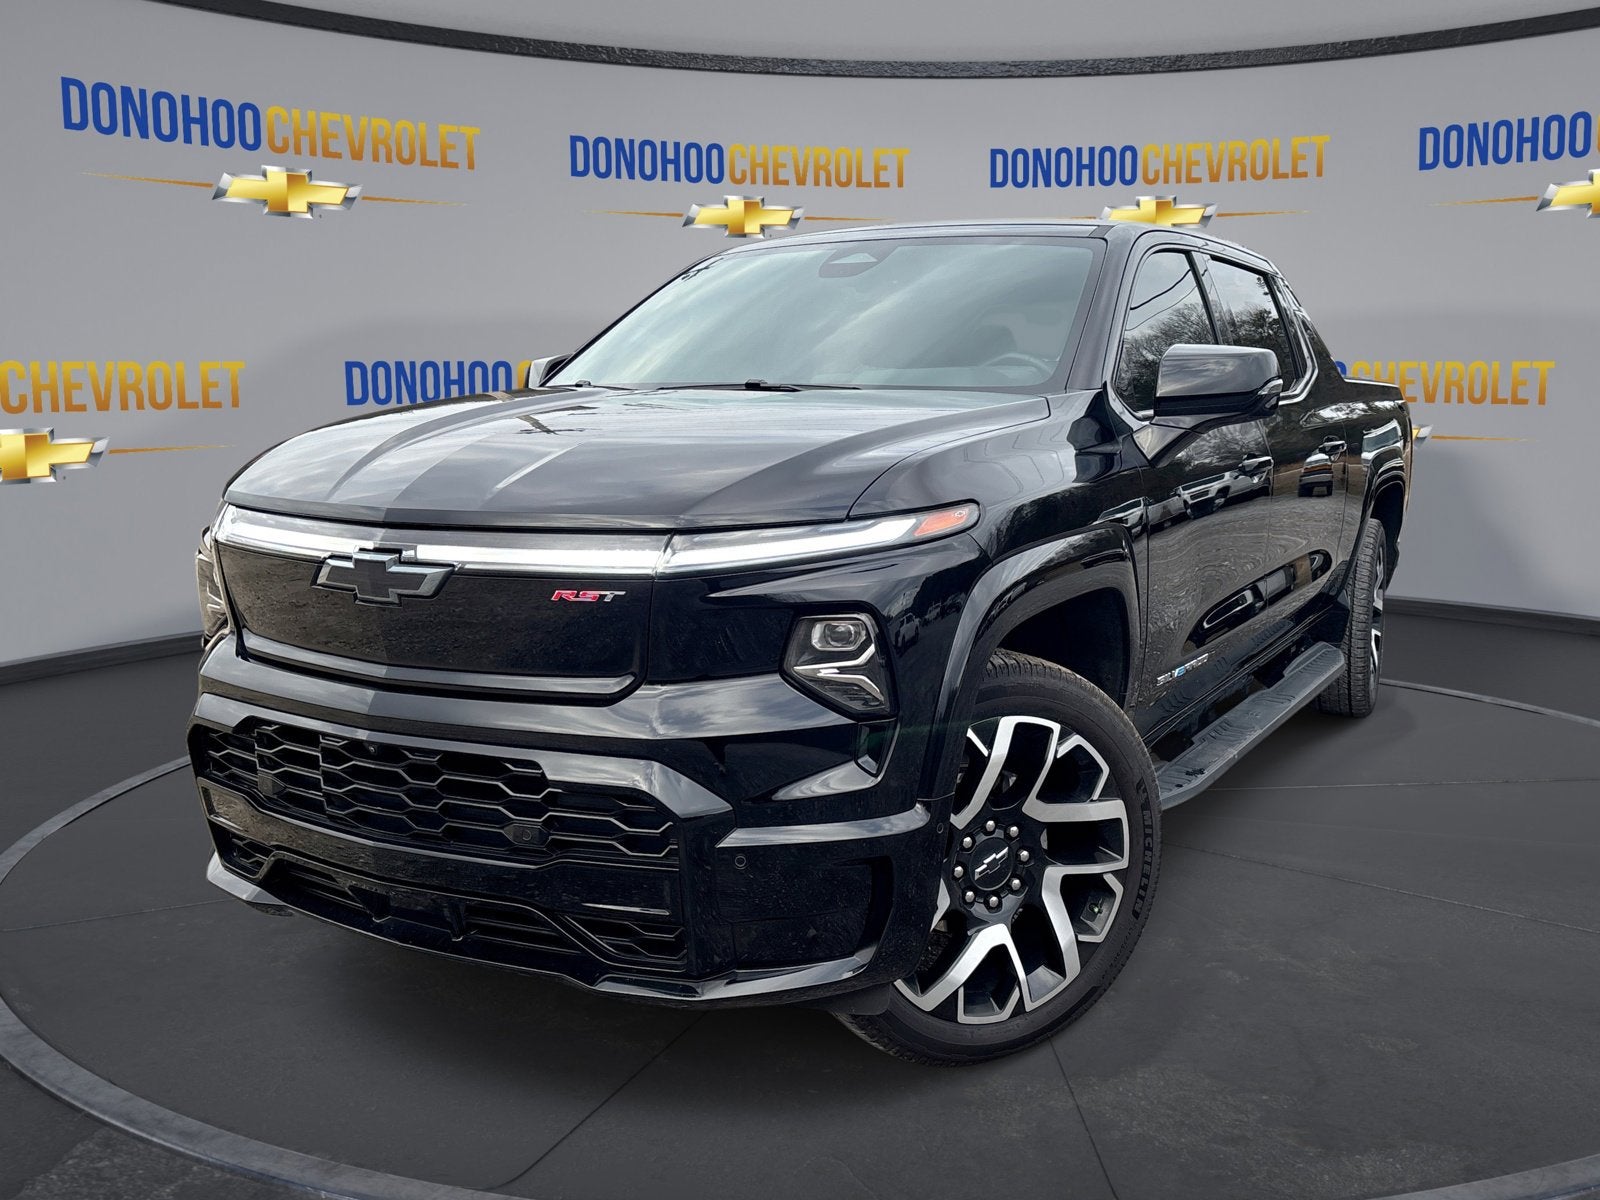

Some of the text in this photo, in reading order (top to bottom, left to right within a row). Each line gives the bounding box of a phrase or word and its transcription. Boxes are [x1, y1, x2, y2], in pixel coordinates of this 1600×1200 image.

[61, 77, 480, 170] DONOHOO CHEVROLET
[1418, 111, 1592, 170] DONOHOO
[569, 135, 910, 188] DONOHOO CHEVROLET
[990, 135, 1331, 188] DONOHOO CHEVROLET
[0, 360, 245, 414] CHEVROLET
[551, 590, 626, 602] RST
[1134, 809, 1153, 913] MICHELIN
